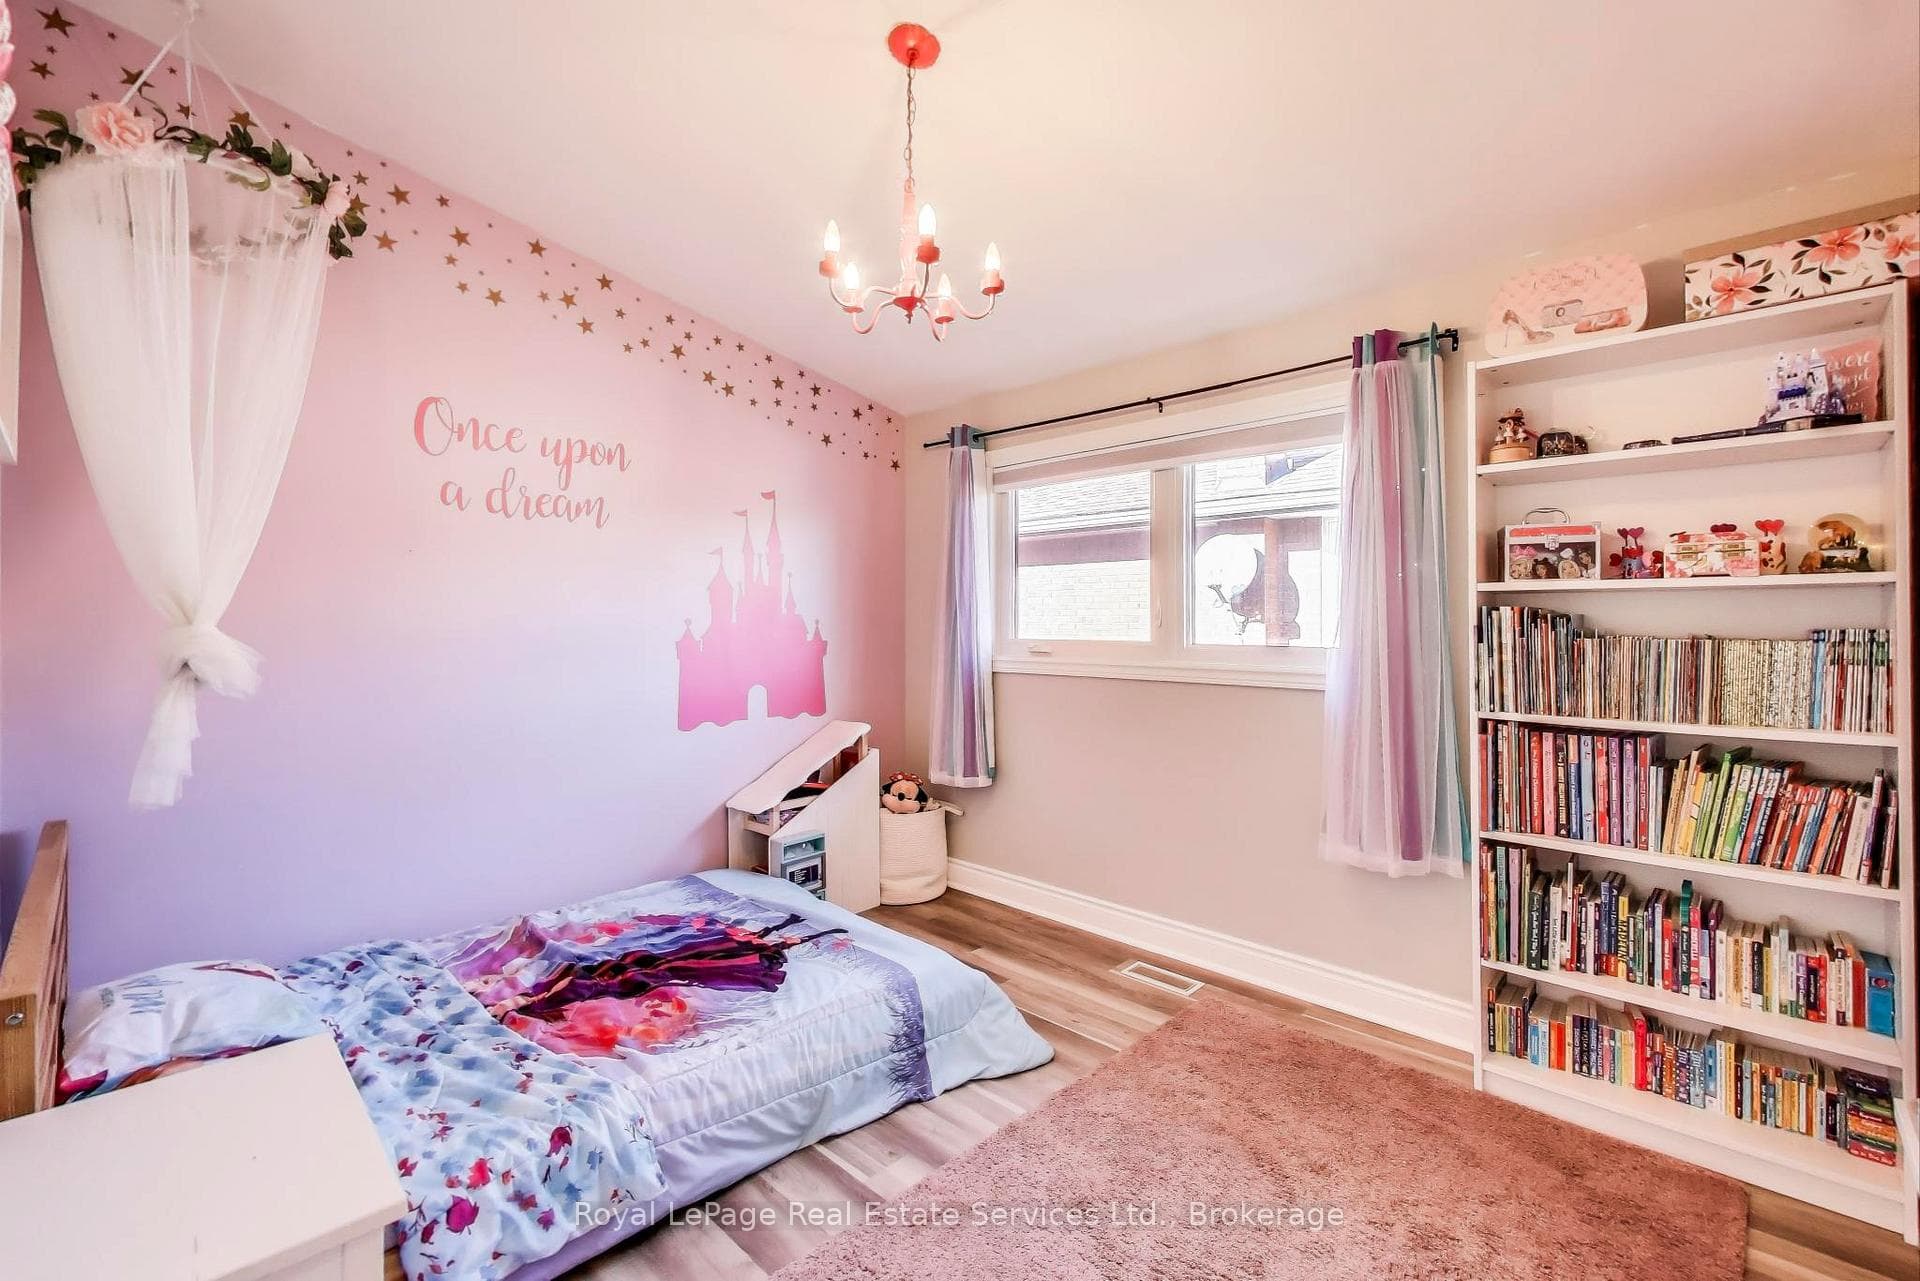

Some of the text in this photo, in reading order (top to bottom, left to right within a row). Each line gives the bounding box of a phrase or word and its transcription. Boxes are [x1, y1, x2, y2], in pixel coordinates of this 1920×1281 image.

[414, 396, 632, 492] Once upon
[440, 467, 610, 530] a dream
